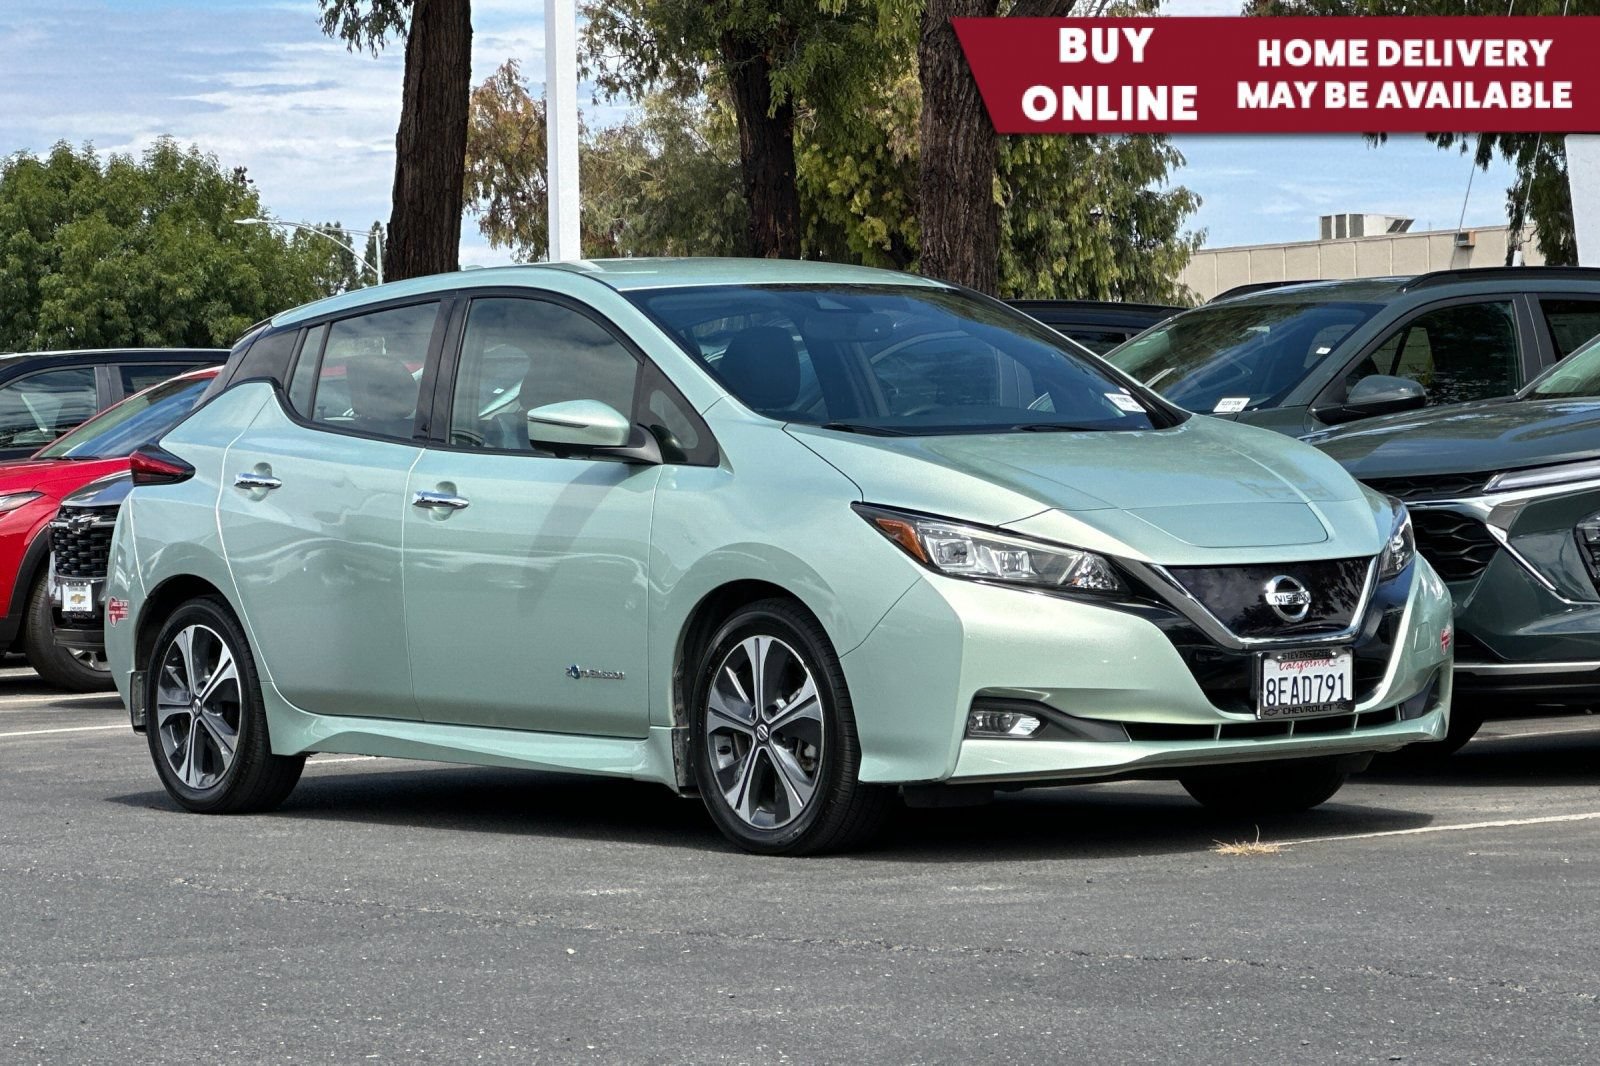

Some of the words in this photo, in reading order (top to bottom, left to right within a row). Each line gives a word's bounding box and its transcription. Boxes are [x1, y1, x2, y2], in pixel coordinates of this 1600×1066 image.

[1274, 592, 1310, 604] NISSAN
[1266, 673, 1346, 707] 8EAD791
[1282, 703, 1333, 715] CHEVROLET
